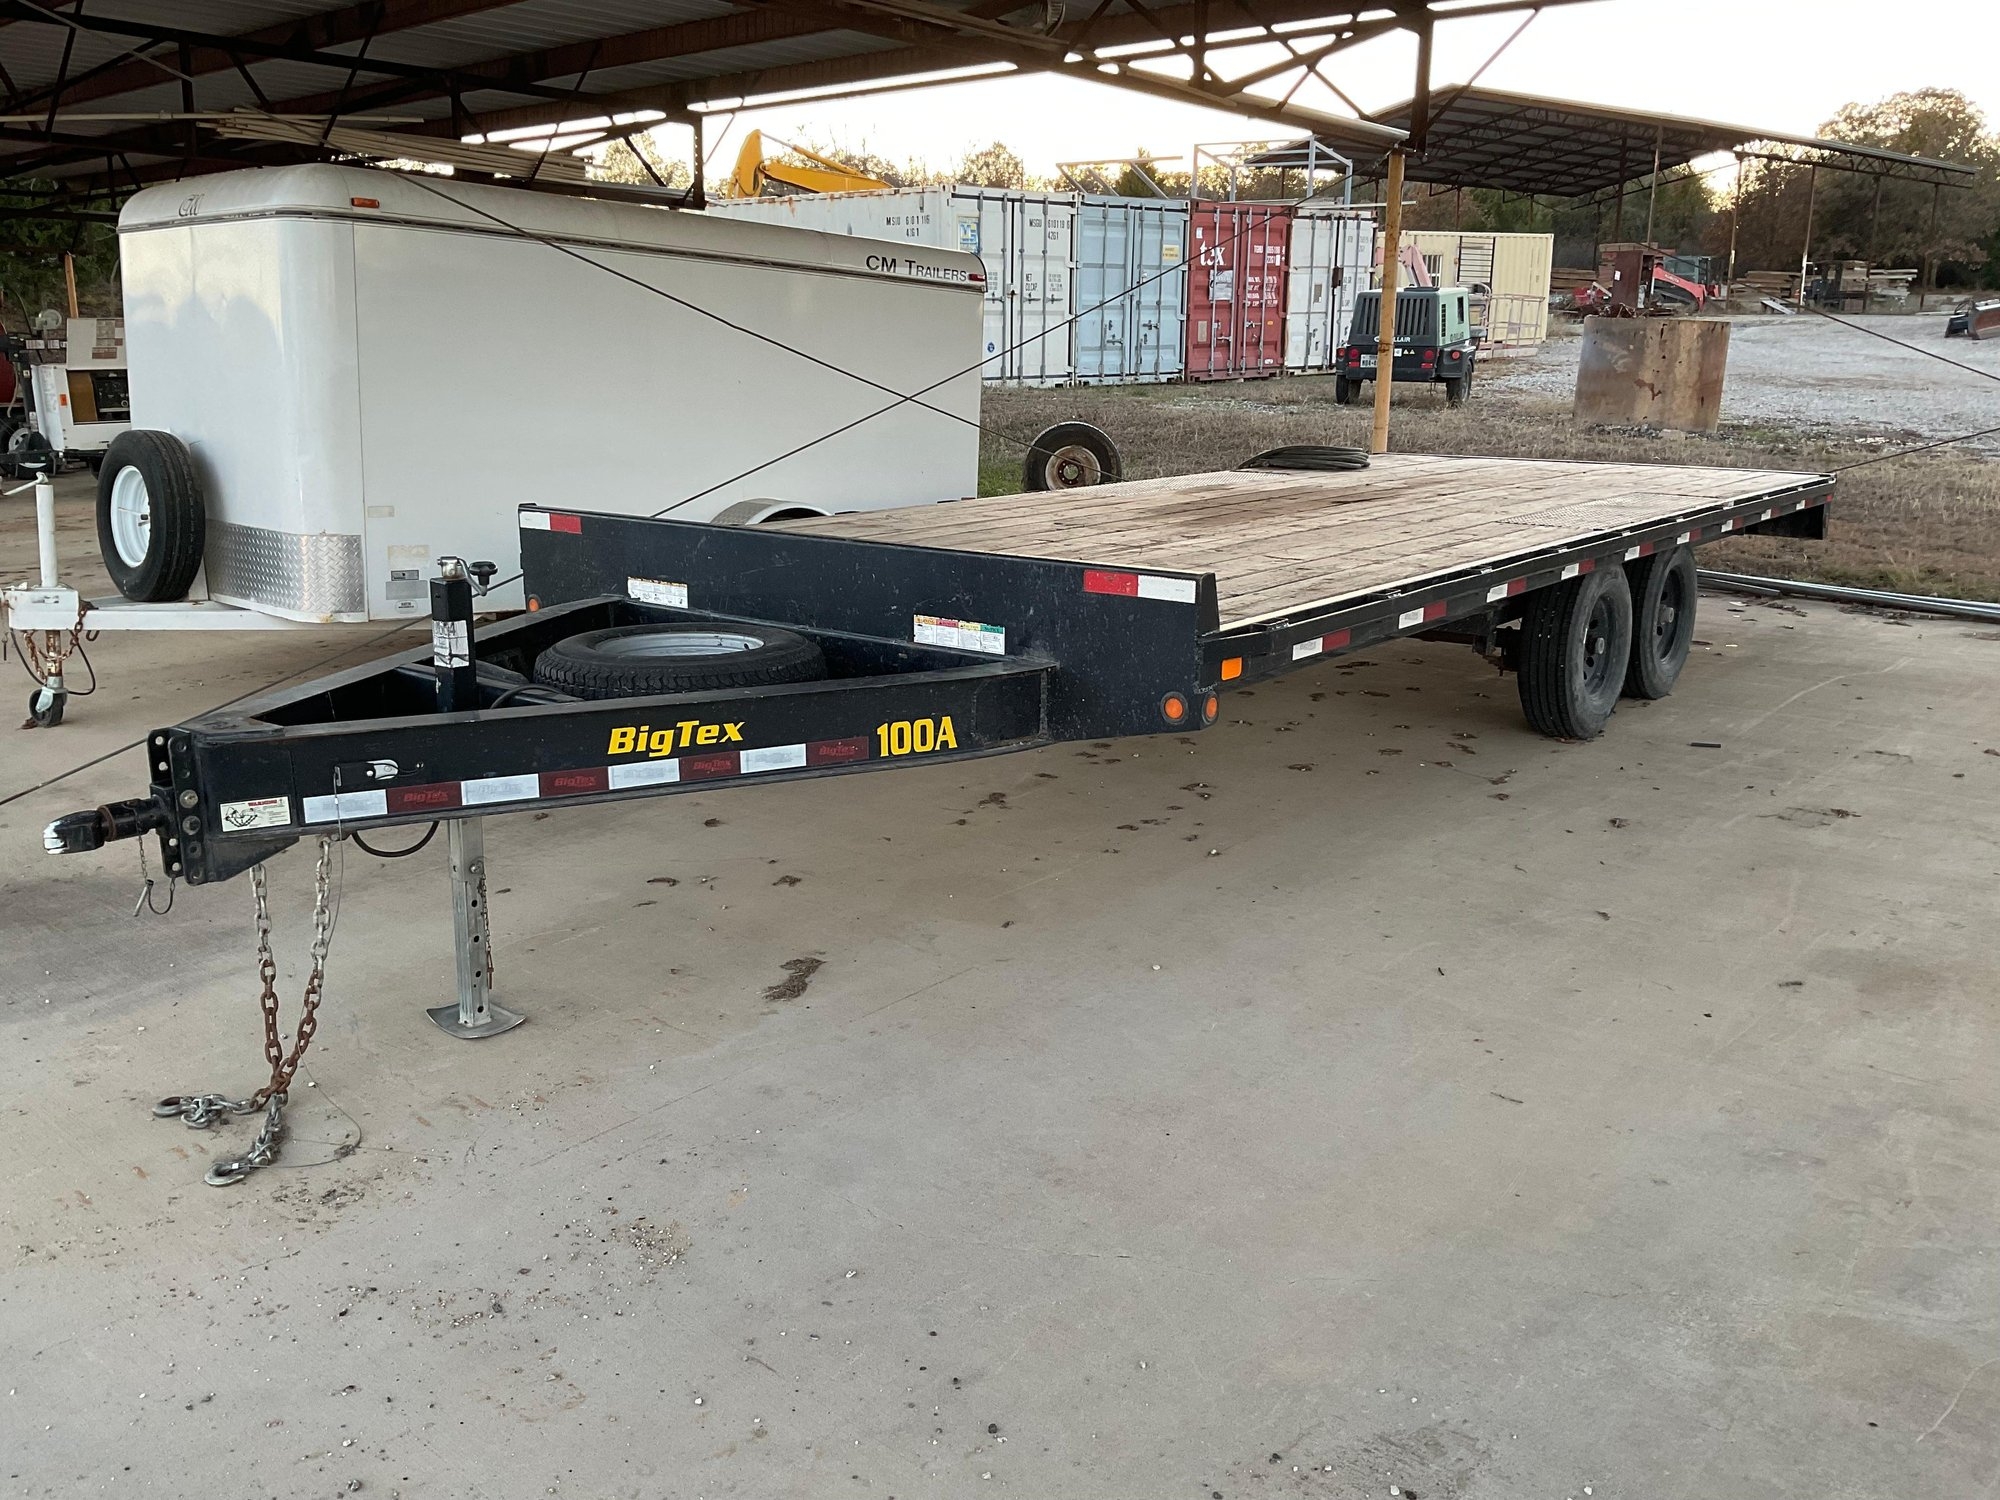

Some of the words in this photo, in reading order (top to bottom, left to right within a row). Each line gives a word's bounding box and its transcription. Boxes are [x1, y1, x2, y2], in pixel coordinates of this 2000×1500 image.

[865, 254, 897, 274] CM
[904, 259, 967, 282] TRAILERS
[607, 721, 746, 757] BigTex
[876, 715, 958, 757] 100A
